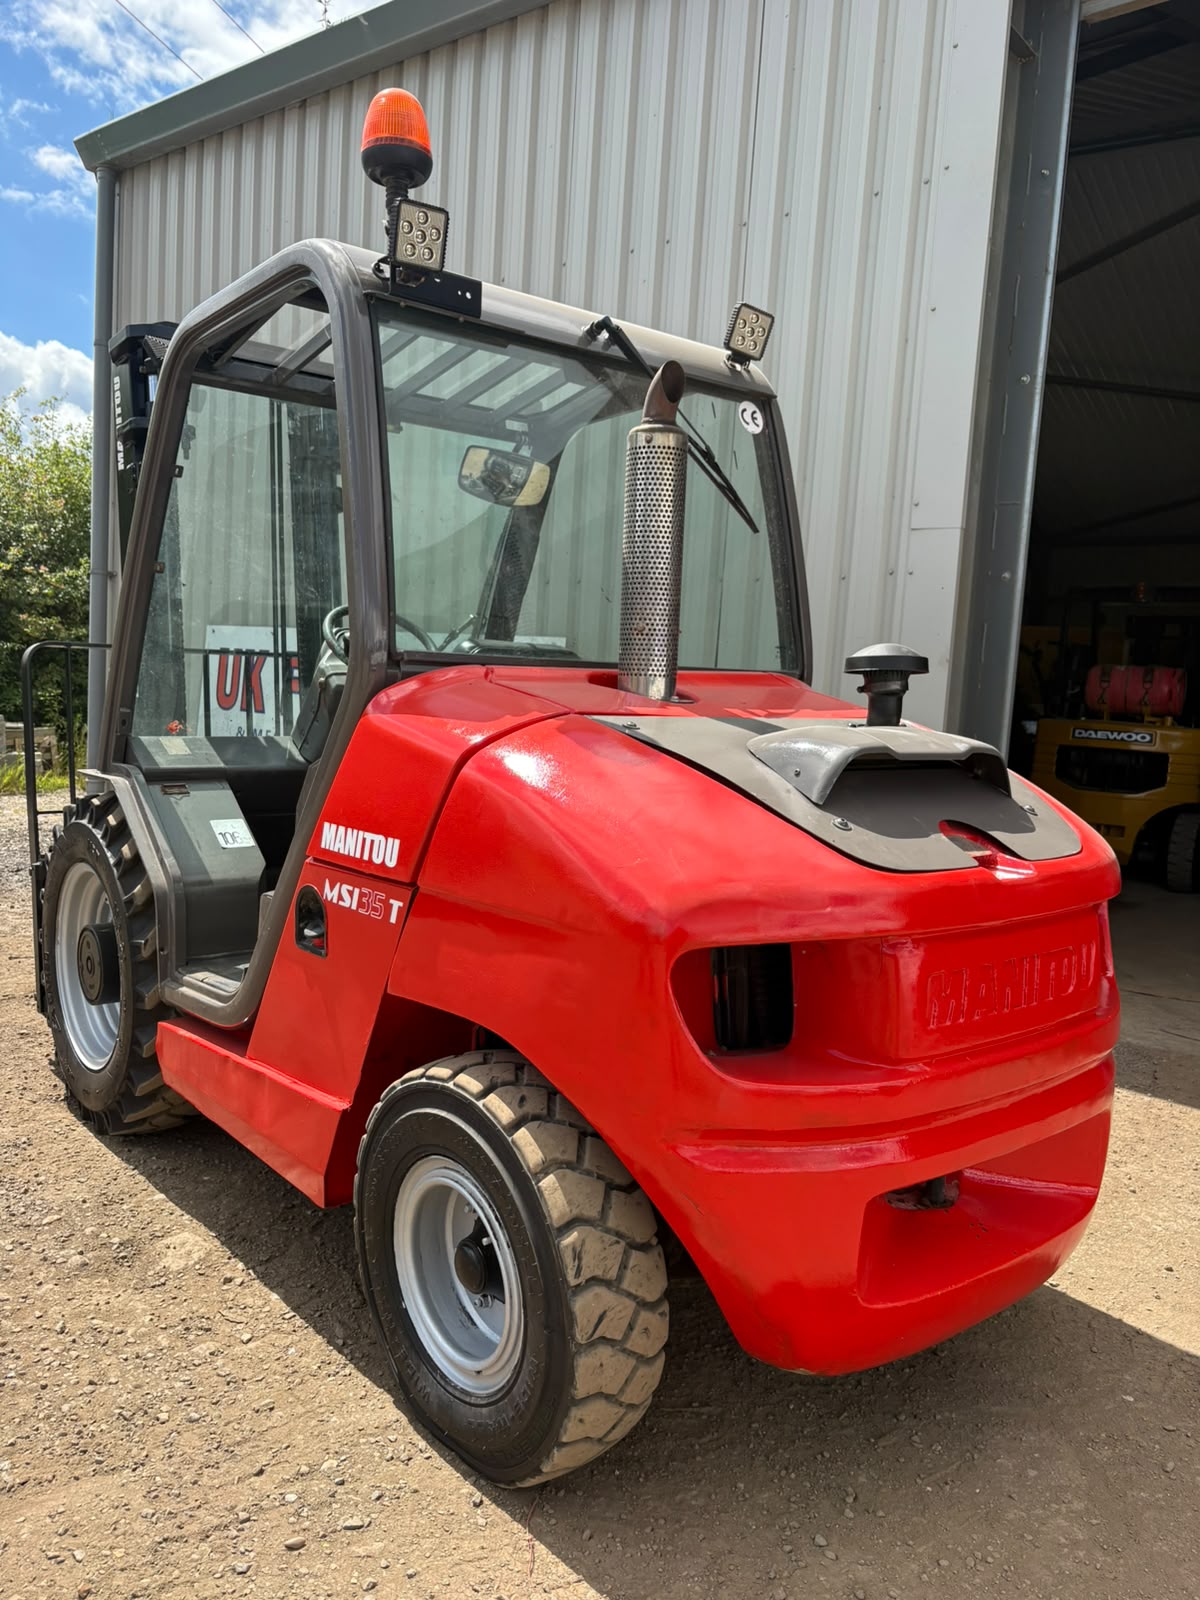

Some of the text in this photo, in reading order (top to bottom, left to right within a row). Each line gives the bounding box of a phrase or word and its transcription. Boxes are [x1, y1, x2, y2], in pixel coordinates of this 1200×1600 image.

[114, 376, 124, 470] MAITOU
[741, 408, 760, 427] CE
[216, 648, 266, 714] UK
[1074, 728, 1152, 743] DAEWOO
[320, 821, 401, 868] MANITOU
[389, 899, 404, 924] T
[926, 940, 1097, 1030] MANITOU
